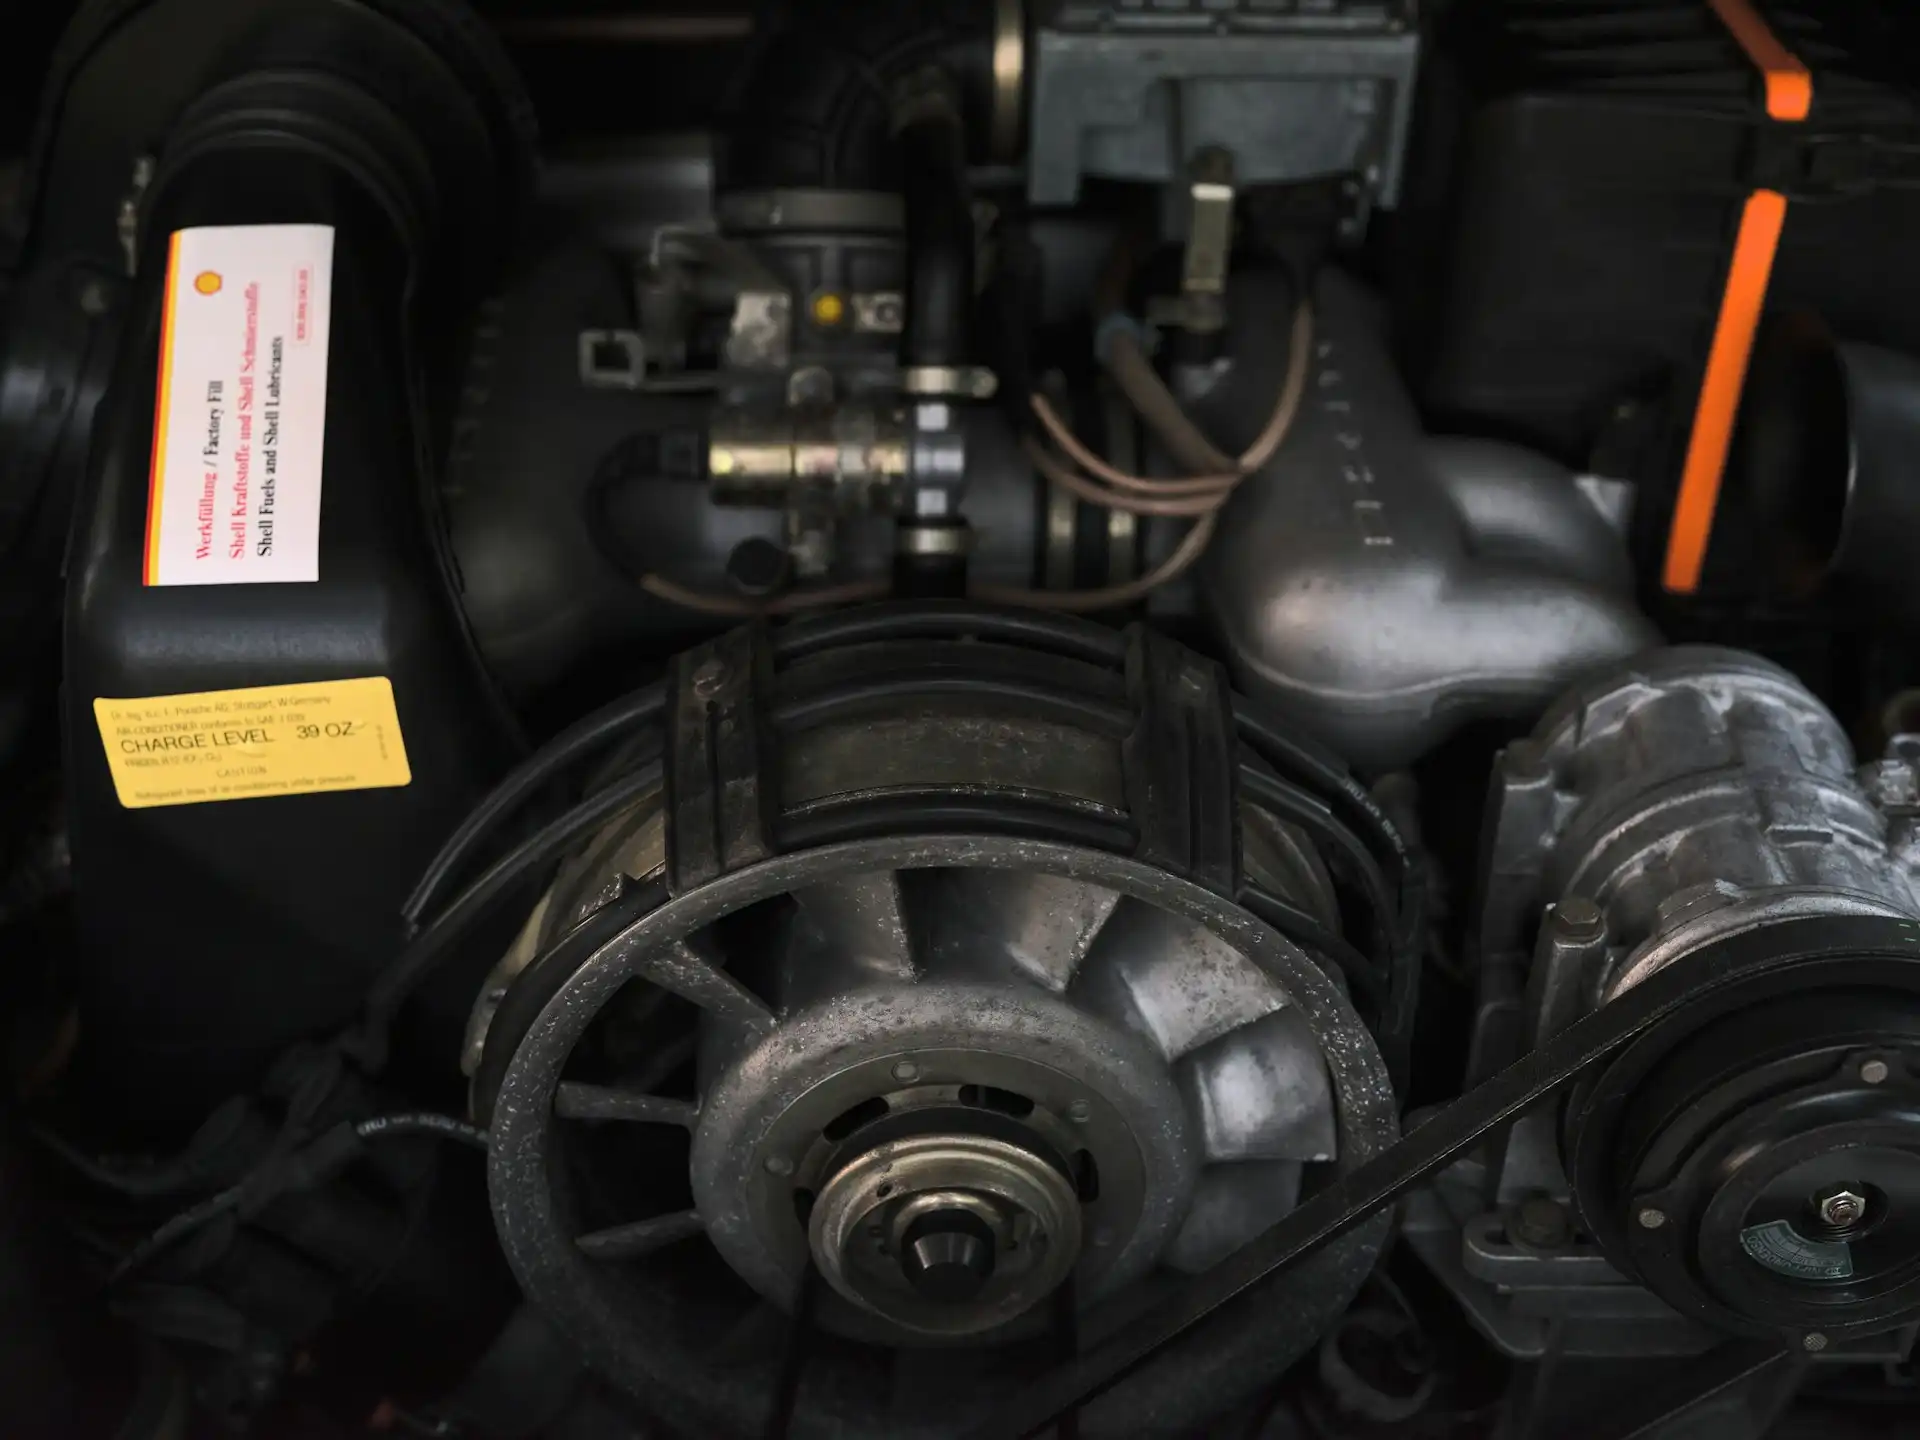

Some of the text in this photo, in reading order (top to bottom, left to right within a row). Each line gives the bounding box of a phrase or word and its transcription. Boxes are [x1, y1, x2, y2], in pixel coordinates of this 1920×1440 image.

[206, 380, 223, 403] Fill
[237, 376, 253, 411] Shell
[203, 408, 225, 456] Factory
[238, 415, 252, 440] und
[256, 336, 284, 557] Shell Fuels and Shell Lubricants
[231, 444, 250, 516] Kraftstoffe
[195, 471, 219, 560] Werkfüllung
[229, 521, 246, 560] Shell
[121, 721, 357, 754] CHARGE LEVEL 39 OZ
